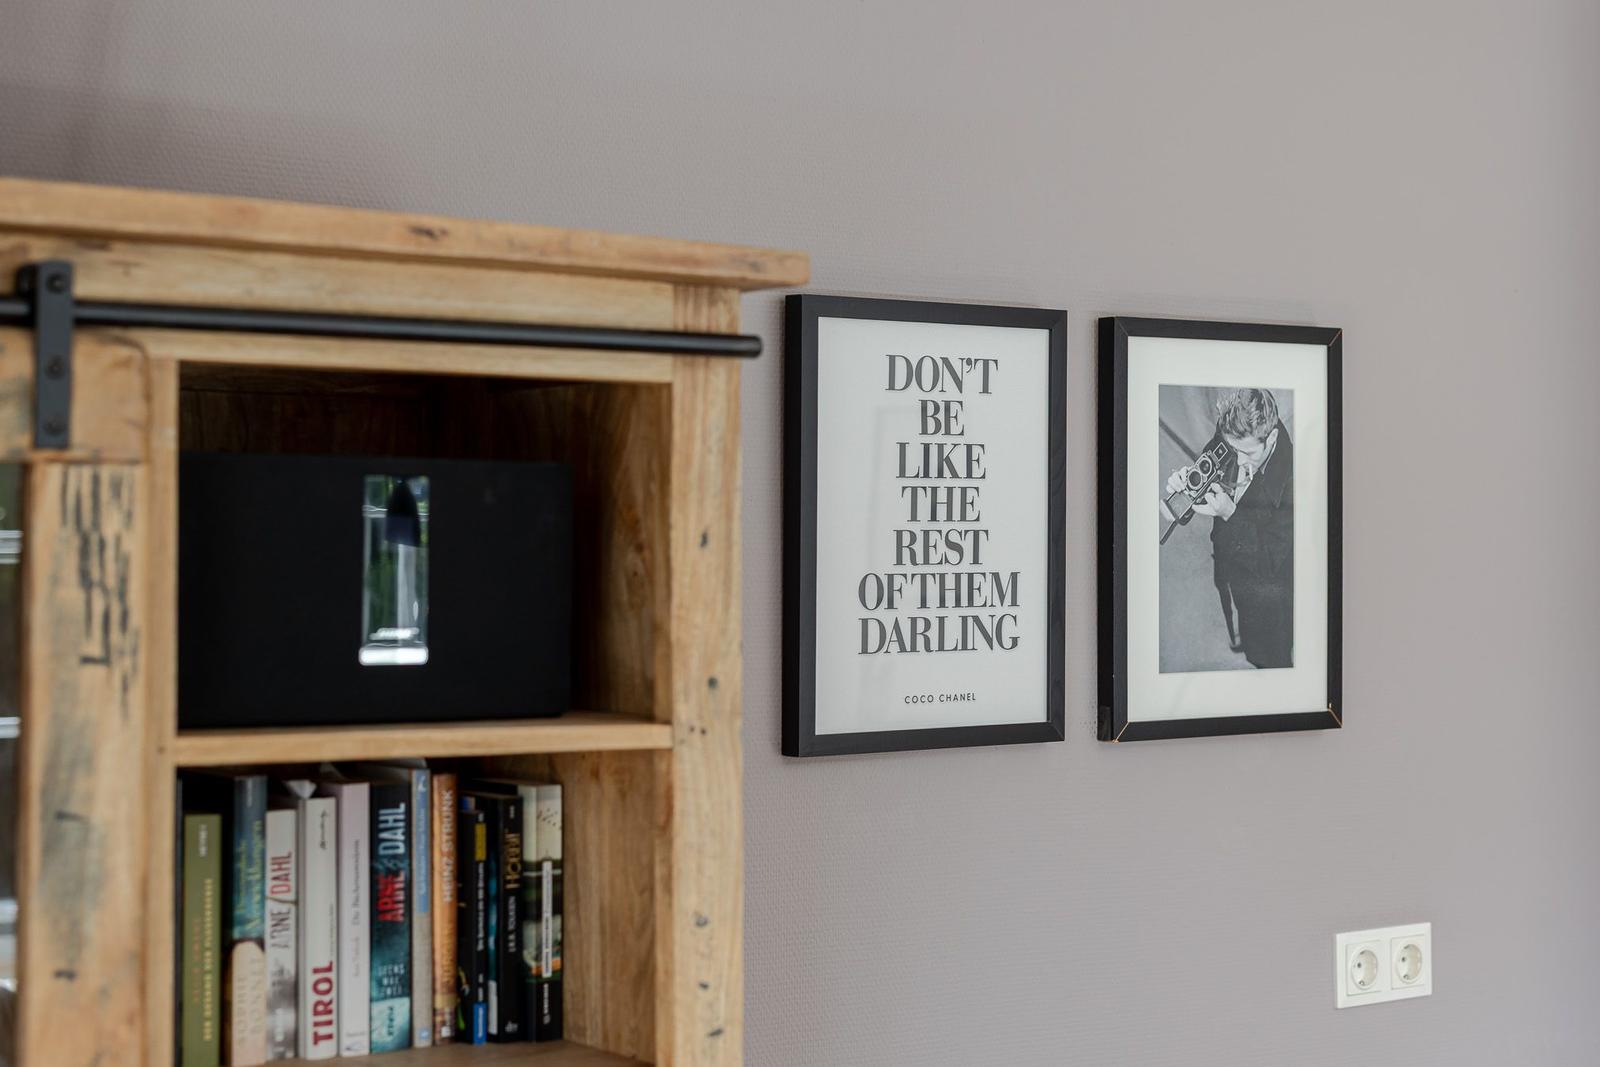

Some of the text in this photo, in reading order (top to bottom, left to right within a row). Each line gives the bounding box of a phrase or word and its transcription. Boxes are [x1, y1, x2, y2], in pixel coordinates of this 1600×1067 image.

[885, 354, 998, 394] DON'T
[918, 399, 964, 436] BE
[896, 442, 986, 479] LIKE
[901, 486, 980, 522] THE
[892, 529, 989, 566] REST
[858, 614, 1020, 655] DARLING
[904, 692, 977, 704] COCO CHANEL
[377, 803, 406, 921] ARNE DAHL
[441, 789, 454, 902] HEINZ STRUNK
[270, 851, 292, 896] DAHL
[312, 961, 334, 1046] TIROL
